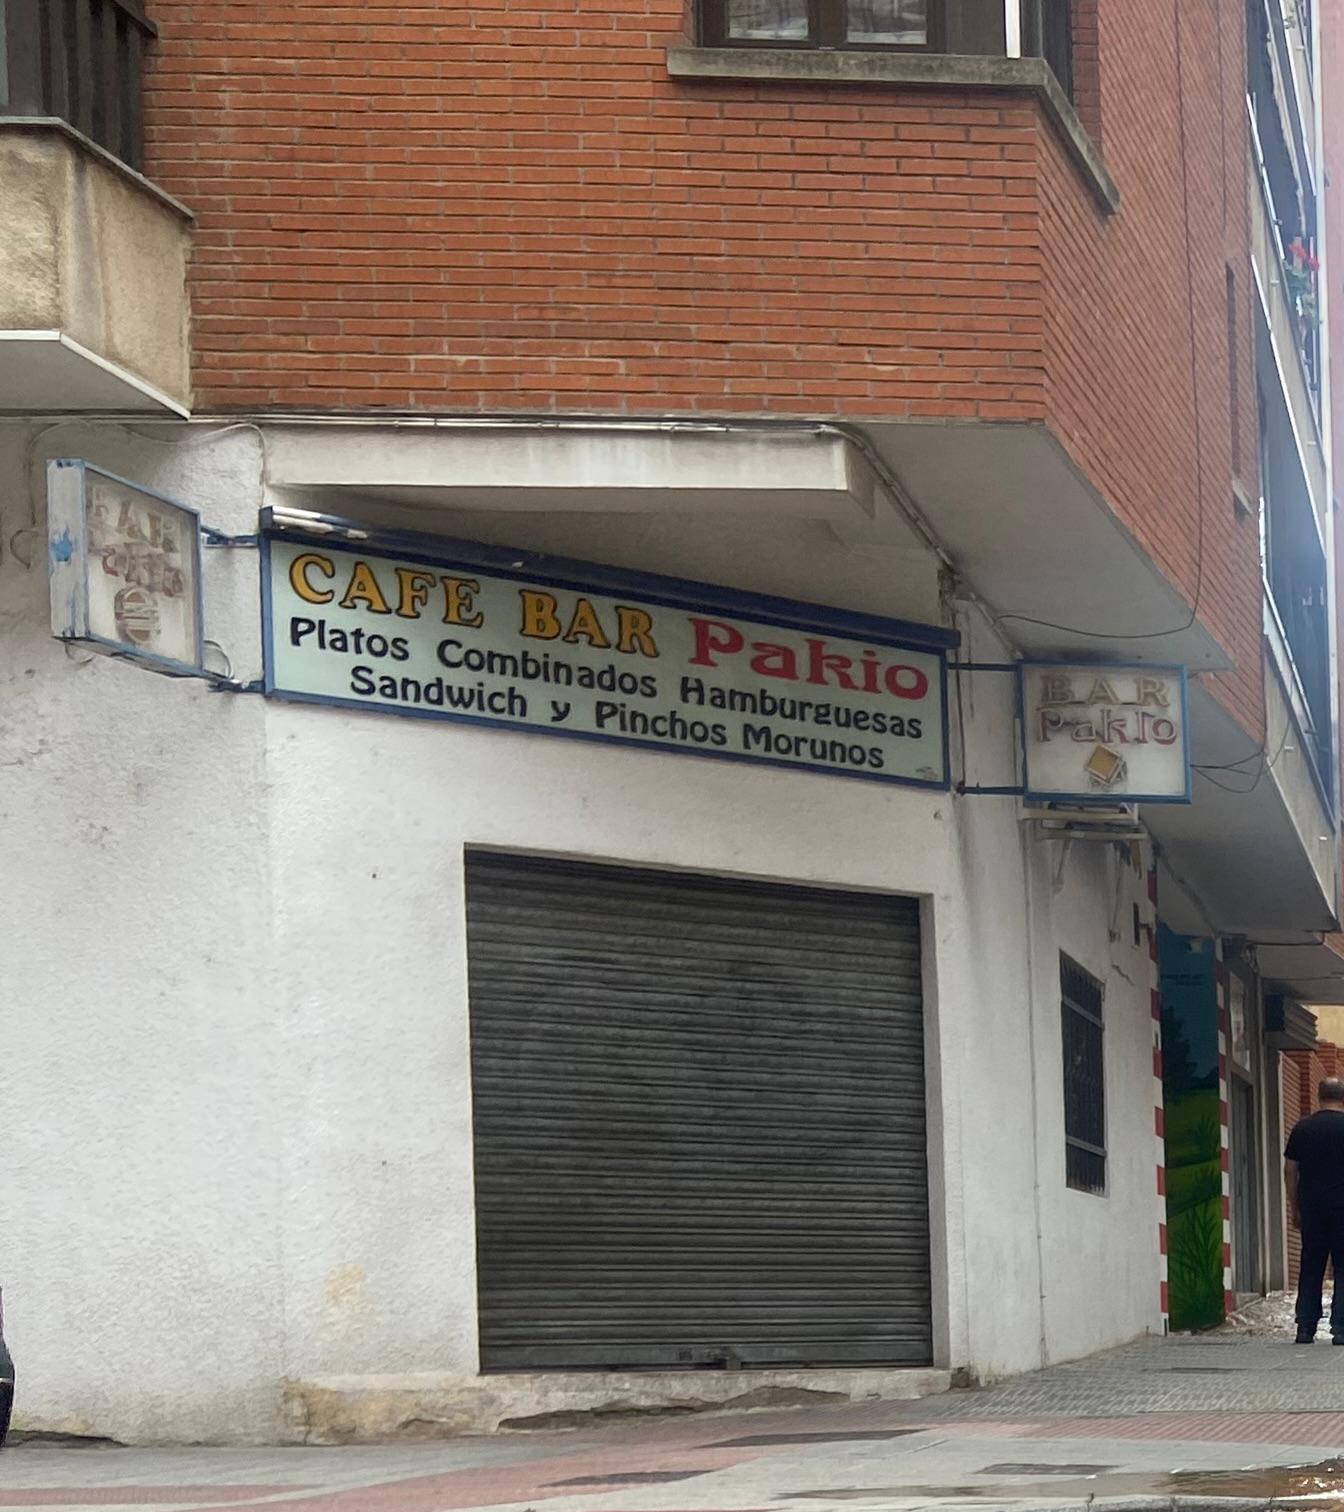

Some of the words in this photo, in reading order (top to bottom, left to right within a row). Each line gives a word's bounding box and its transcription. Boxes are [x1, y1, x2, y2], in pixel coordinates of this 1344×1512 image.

[289, 553, 484, 629] CAFE
[518, 589, 660, 658] BAR
[687, 617, 929, 701] Pakio
[290, 617, 409, 661] Platos
[436, 639, 658, 698] Combinados
[680, 676, 922, 739] Hamburguesas
[350, 665, 527, 718] Sandwich
[550, 700, 571, 722] y
[595, 701, 727, 746] Pinchos
[743, 723, 884, 769] Morunos
[1040, 674, 1170, 708] BAR
